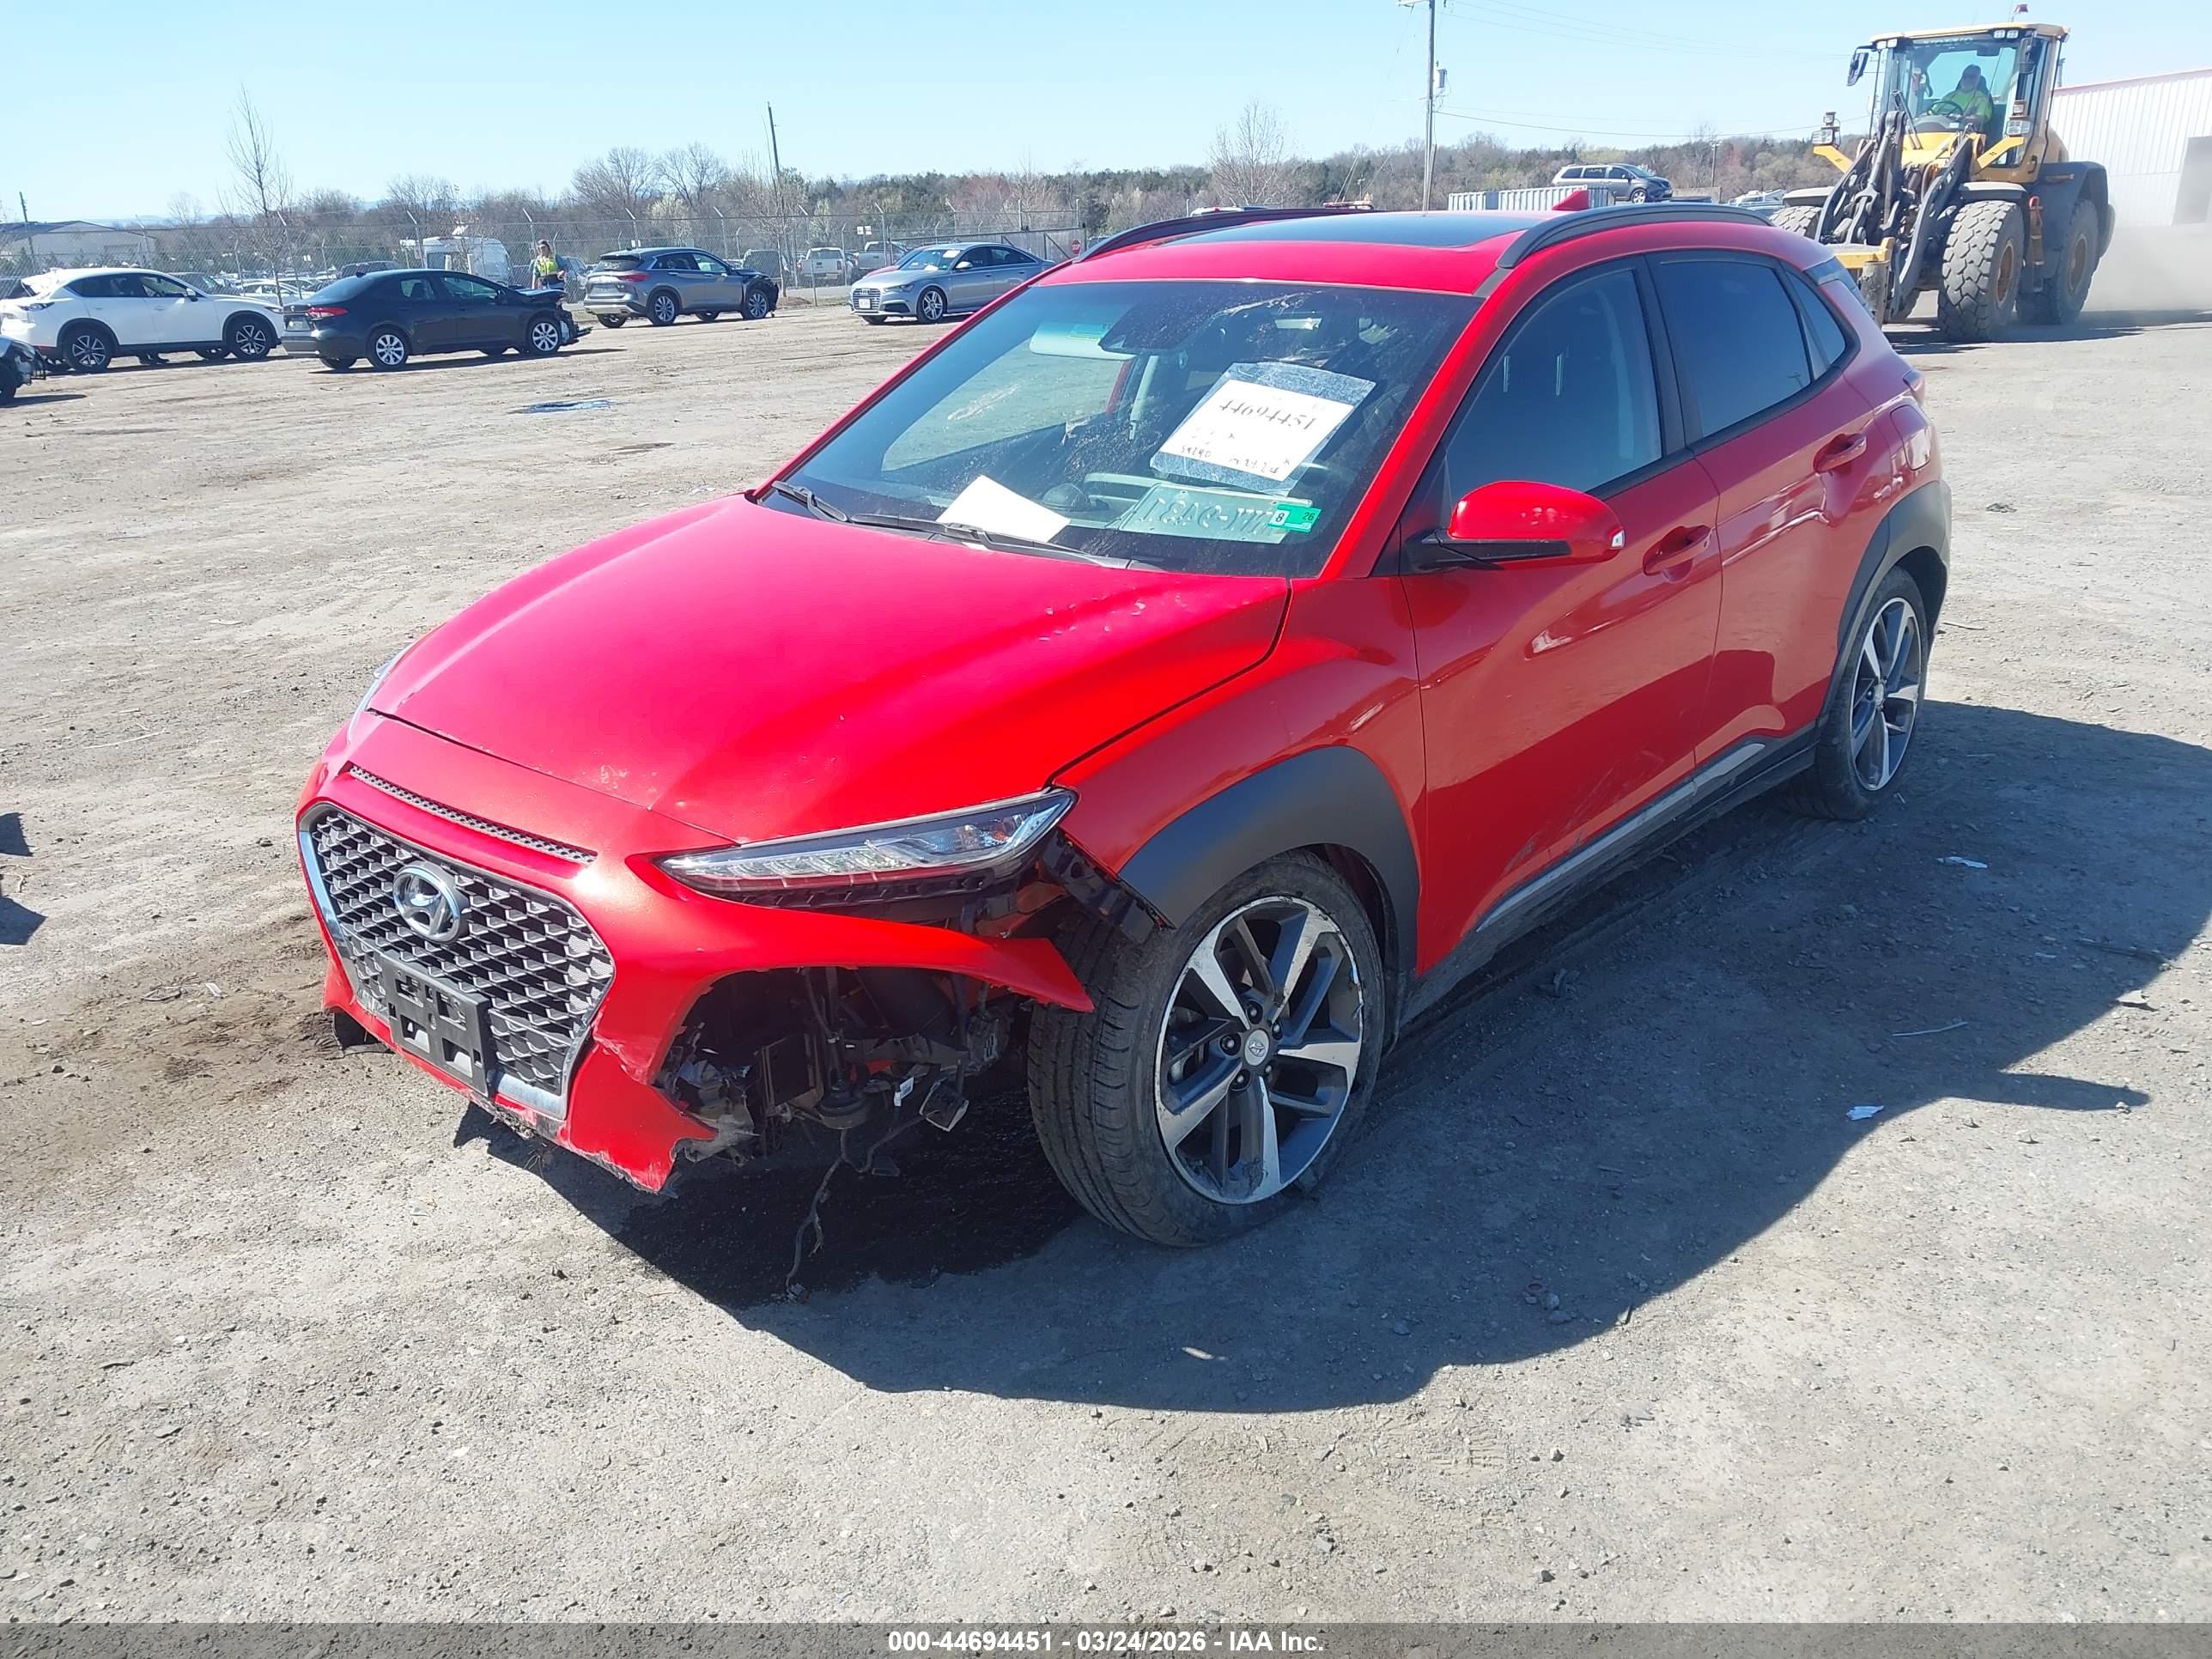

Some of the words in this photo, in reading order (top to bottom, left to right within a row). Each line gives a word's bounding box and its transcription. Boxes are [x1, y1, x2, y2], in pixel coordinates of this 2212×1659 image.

[1219, 399, 1317, 430] 44694451
[1275, 512, 1285, 523] 8
[1302, 512, 1316, 521] 26
